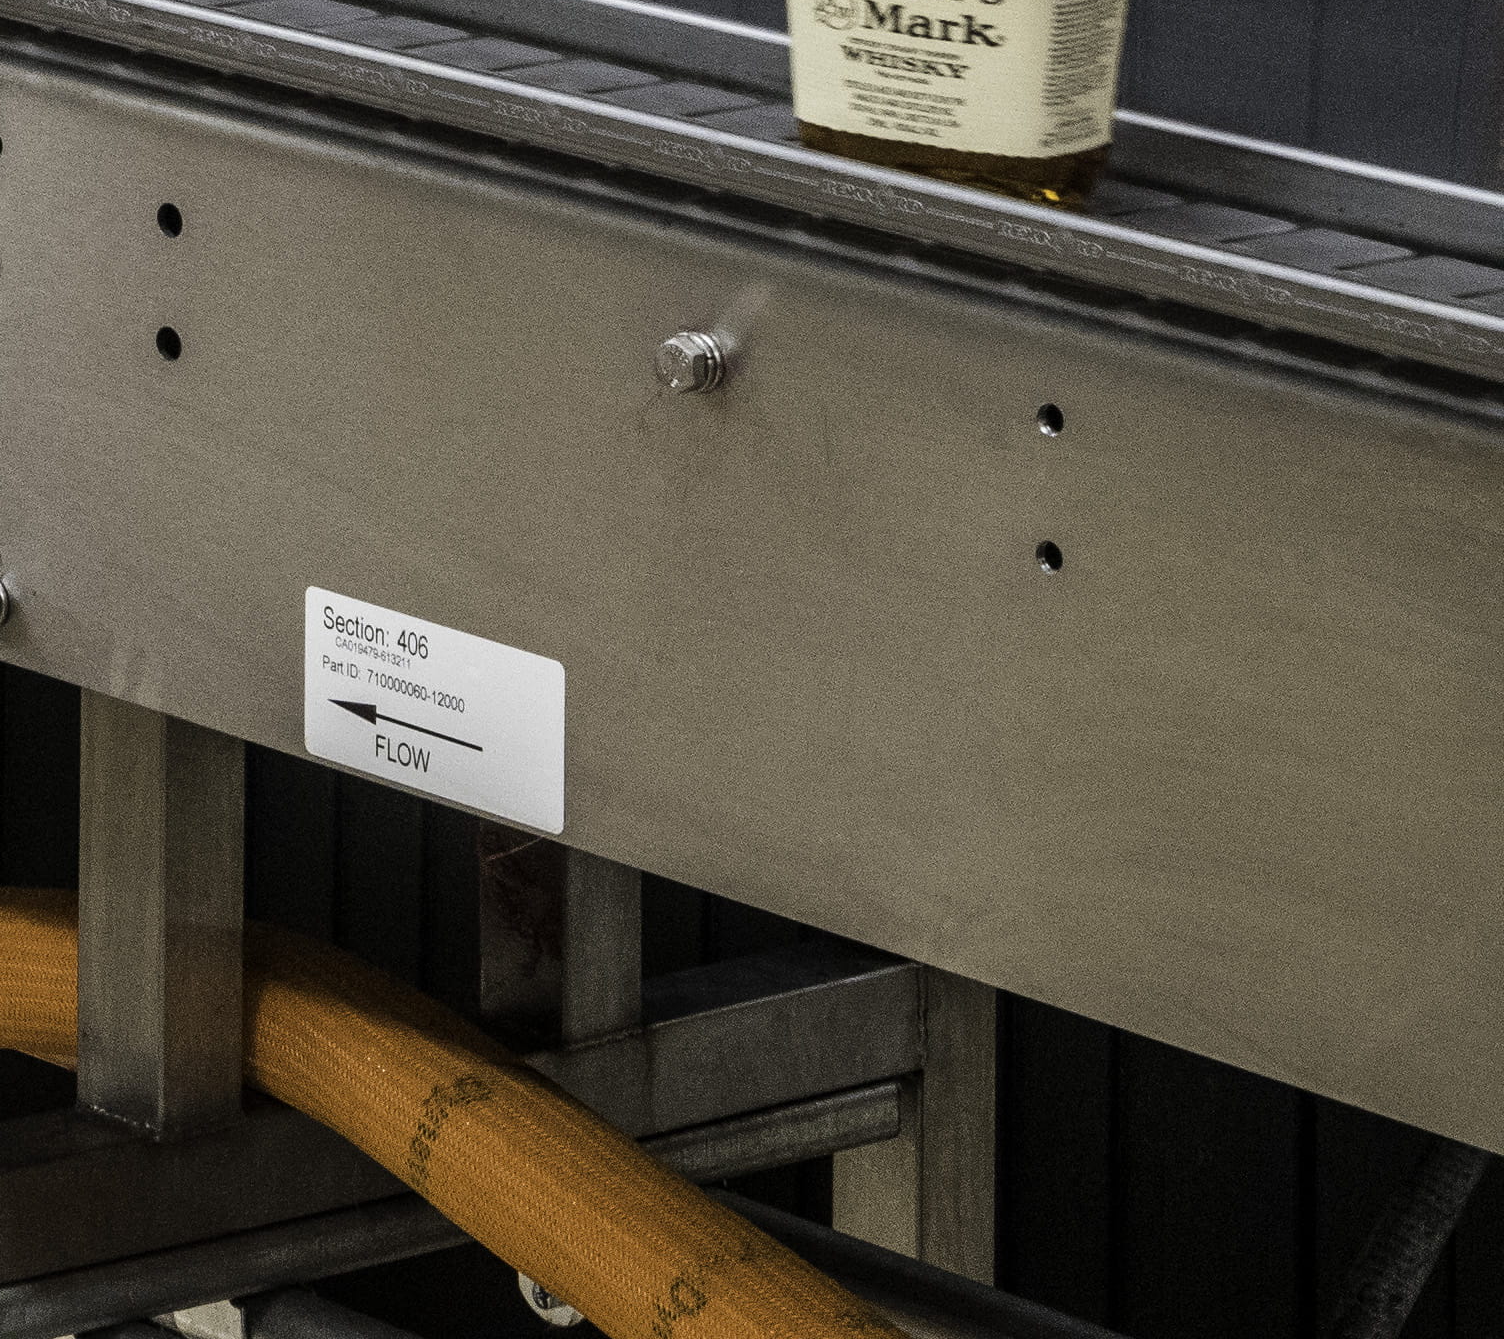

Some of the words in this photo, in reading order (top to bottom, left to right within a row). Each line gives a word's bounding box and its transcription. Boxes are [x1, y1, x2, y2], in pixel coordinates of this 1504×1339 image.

[839, 43, 970, 81] WHISKY
[322, 605, 391, 649] Section:
[396, 629, 429, 661] 406
[321, 654, 345, 677] Part
[346, 662, 362, 681] ID:
[374, 734, 431, 774] FLOW
